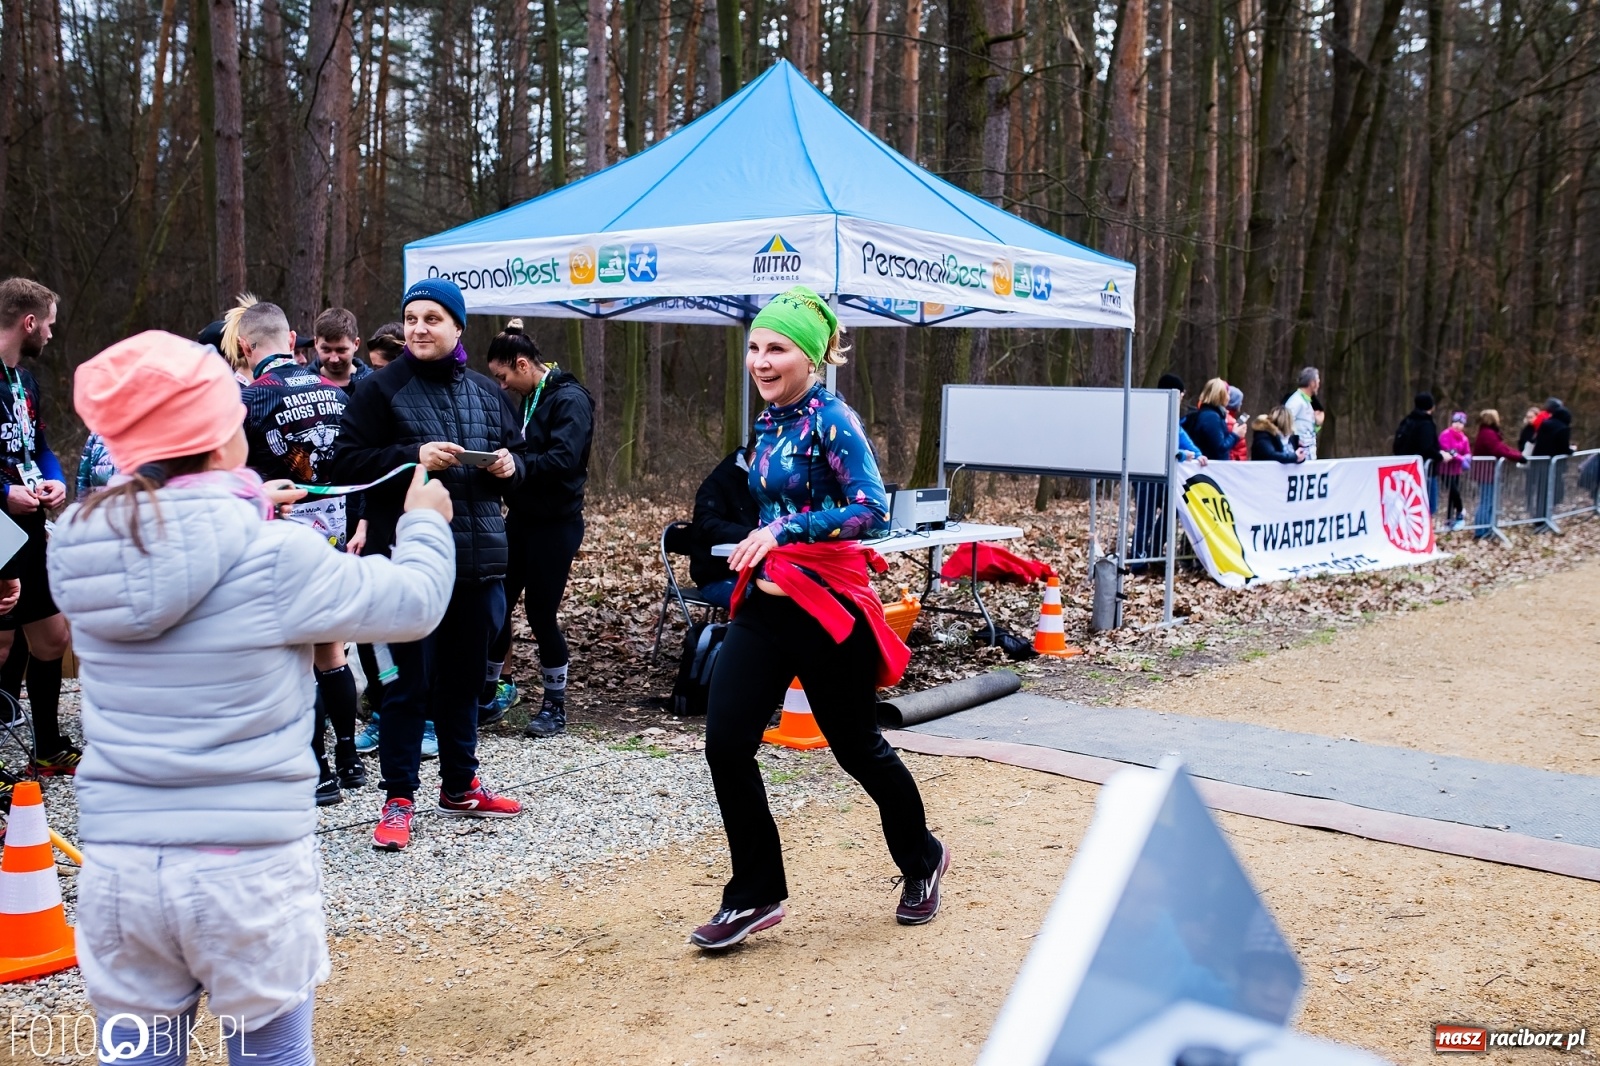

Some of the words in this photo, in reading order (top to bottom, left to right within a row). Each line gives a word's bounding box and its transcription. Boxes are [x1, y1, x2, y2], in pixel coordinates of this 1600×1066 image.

[753, 254, 801, 273] MITKO
[862, 241, 987, 289] PersonalBest
[283, 389, 339, 409] RACIBÓRZ
[275, 405, 316, 426] CROSS
[317, 401, 347, 416] GAME
[1286, 472, 1329, 503] BIEG
[1201, 497, 1234, 522] IR
[1250, 510, 1368, 552] TWARDZIELA
